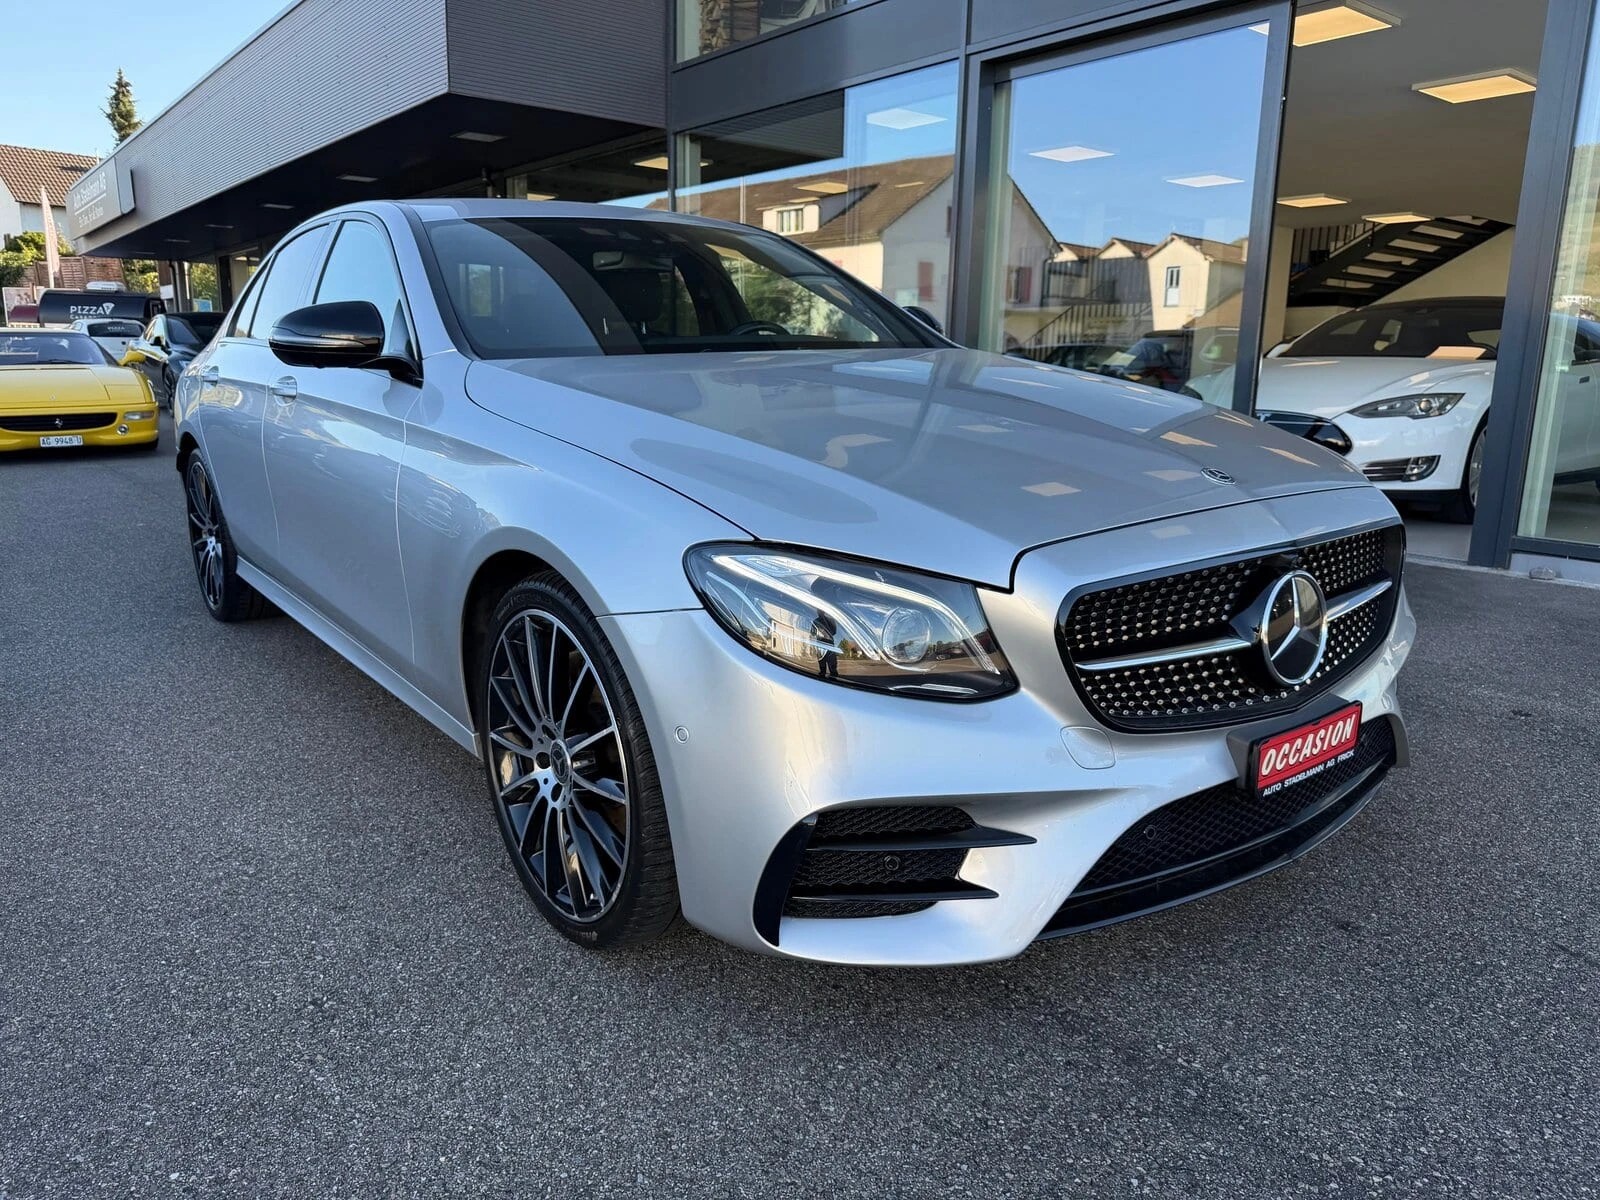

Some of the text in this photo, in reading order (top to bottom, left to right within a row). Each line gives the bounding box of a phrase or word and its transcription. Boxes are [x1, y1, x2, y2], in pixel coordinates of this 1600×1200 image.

[70, 305, 105, 315] PIZZA
[41, 437, 51, 446] AG
[55, 437, 73, 446] 9948
[1261, 713, 1356, 776] OCCASION
[1263, 749, 1355, 797] AUTO STADELMANN AG FRICK
